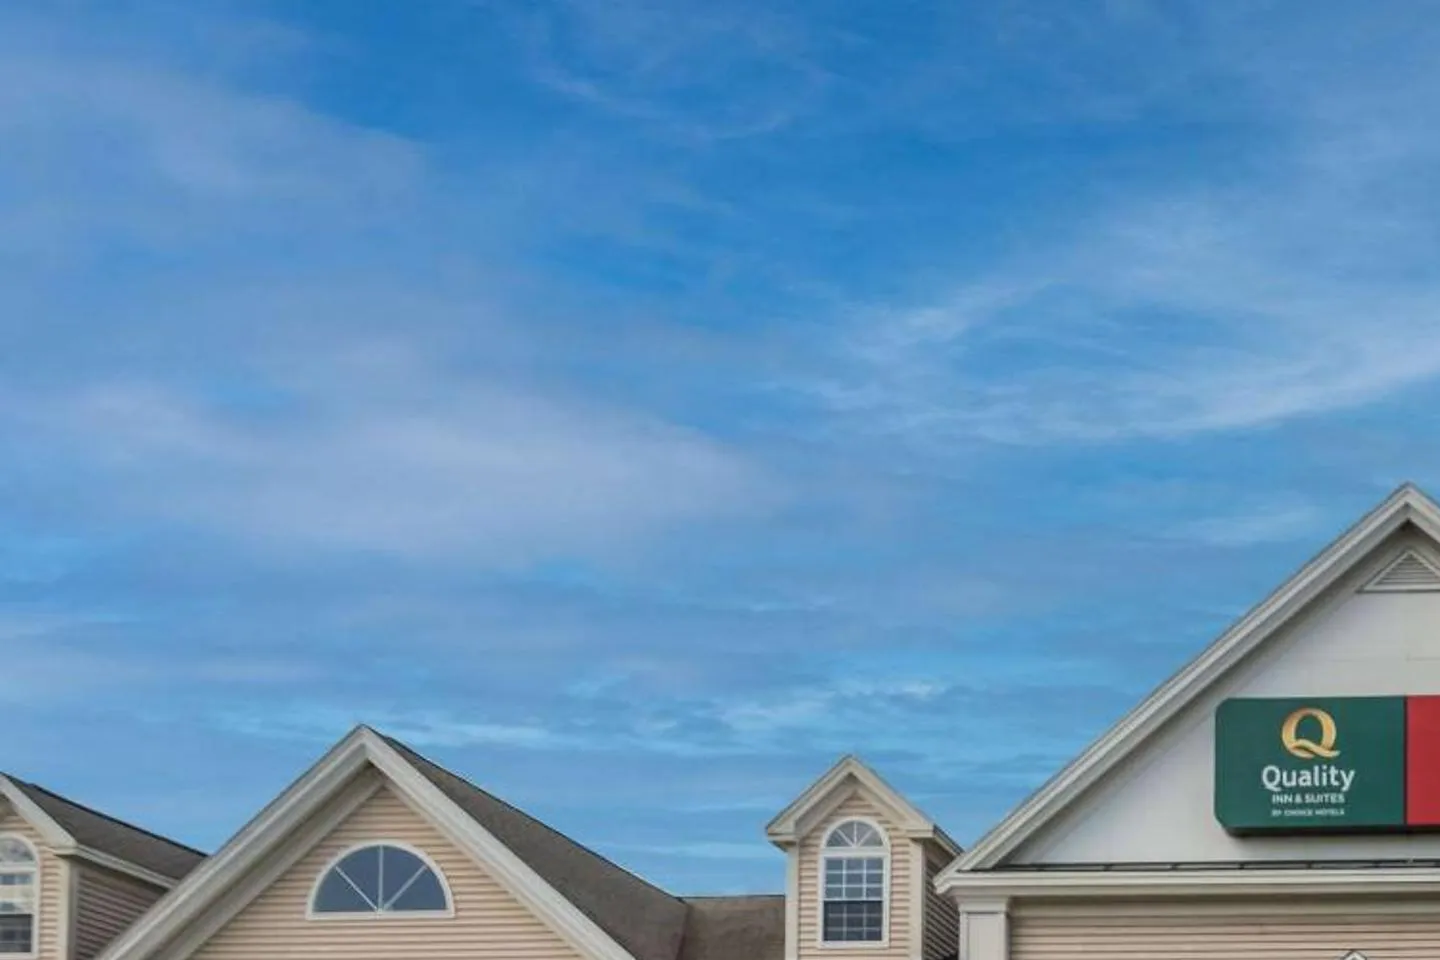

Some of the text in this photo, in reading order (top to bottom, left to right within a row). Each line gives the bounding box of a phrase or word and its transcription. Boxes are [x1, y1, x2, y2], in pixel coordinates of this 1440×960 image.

[1262, 764, 1355, 792] Quality
[1272, 793, 1293, 804] INN
[1304, 792, 1345, 804] SUITES
